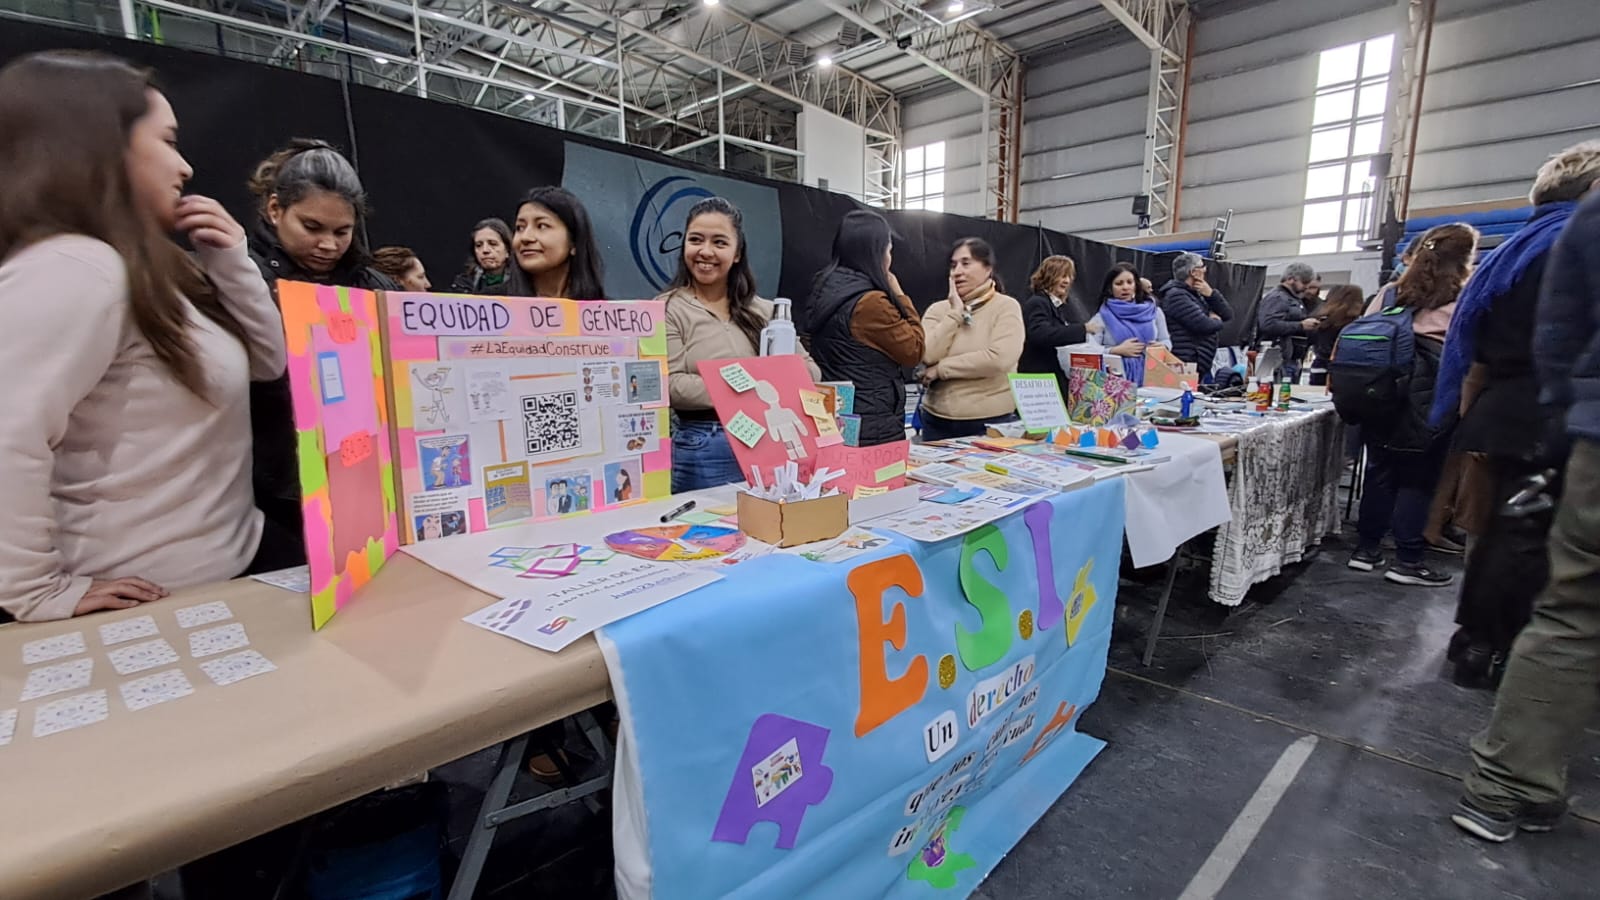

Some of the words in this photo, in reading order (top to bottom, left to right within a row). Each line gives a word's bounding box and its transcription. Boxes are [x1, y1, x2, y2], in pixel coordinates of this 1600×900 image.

[403, 301, 510, 331] EQUIDAD
[529, 305, 561, 328] DE
[582, 304, 653, 333] GÉNERO
[470, 341, 610, 357] #LaEquidadConstruye
[547, 576, 608, 598] TALLER
[610, 570, 629, 580] DE
[928, 720, 953, 753] Un
[969, 663, 1034, 727] derecho
